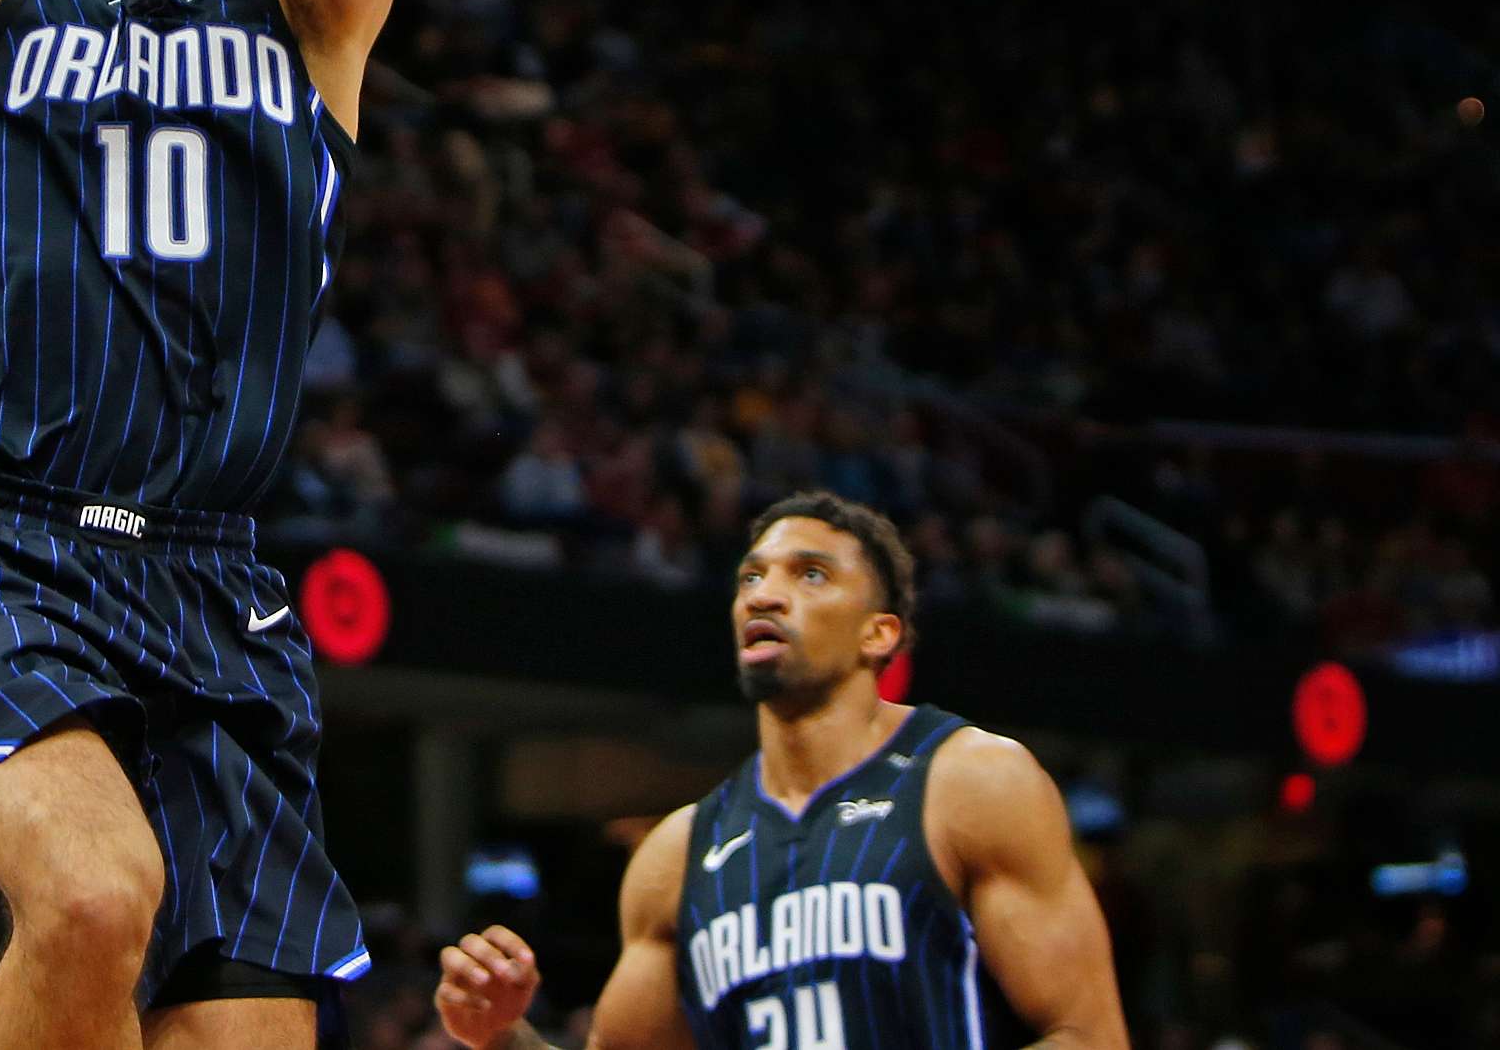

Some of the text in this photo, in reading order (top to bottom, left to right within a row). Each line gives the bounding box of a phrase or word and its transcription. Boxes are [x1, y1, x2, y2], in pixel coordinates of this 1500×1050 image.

[4, 21, 296, 127] ORLANDO
[96, 121, 211, 262] 10
[79, 505, 146, 539] MAGIC
[836, 798, 894, 826] Disney
[689, 880, 907, 1012] ORLANDO
